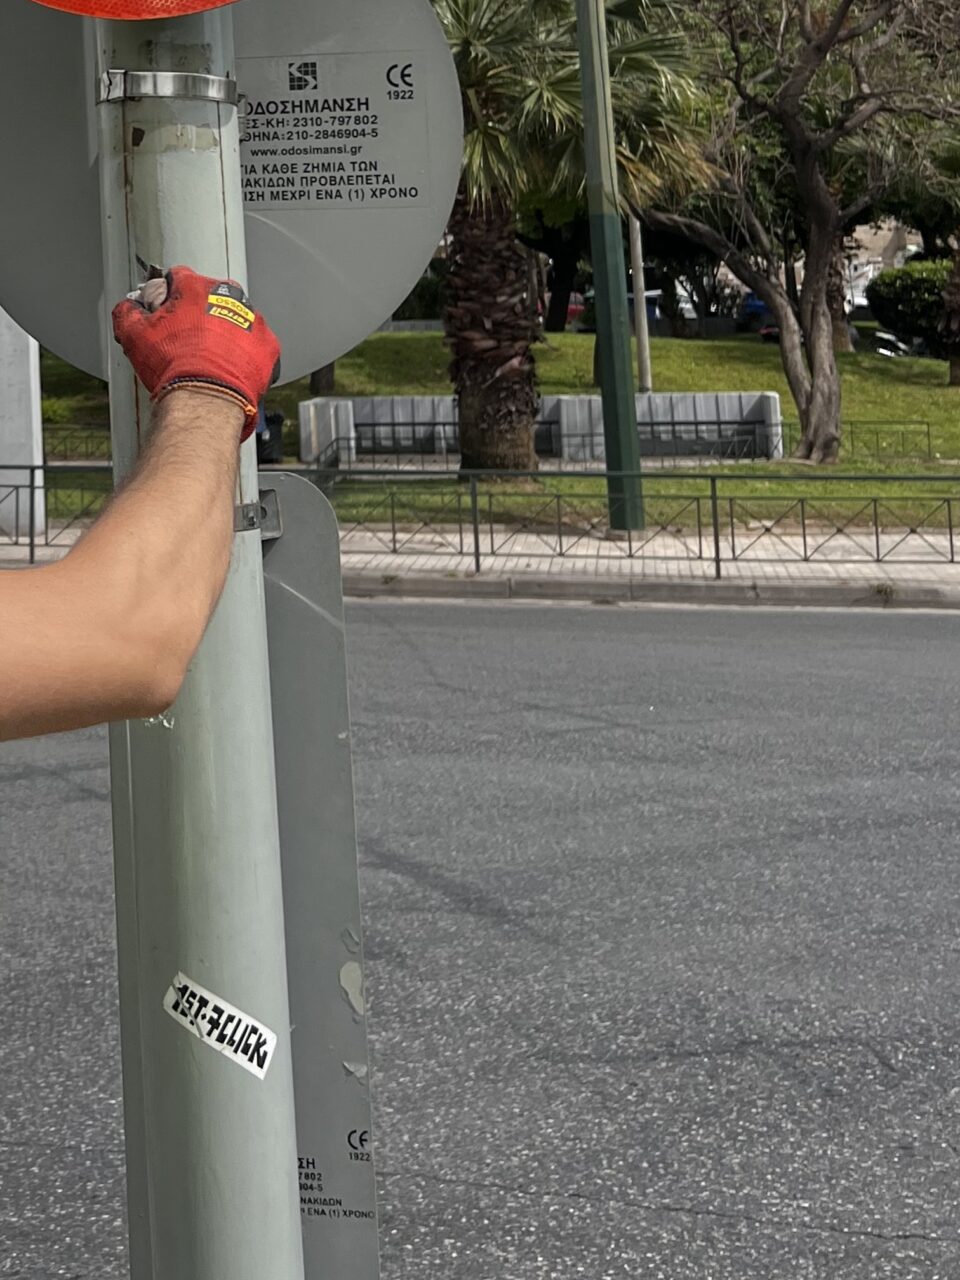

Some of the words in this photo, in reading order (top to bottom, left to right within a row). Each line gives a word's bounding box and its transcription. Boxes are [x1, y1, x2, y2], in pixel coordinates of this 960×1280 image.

[386, 90, 414, 100] 1922
[250, 144, 362, 157] www.odosimansi.gr
[240, 163, 257, 175] ΙΑ
[262, 162, 298, 174] ΚΑΘΕ
[302, 161, 346, 173] ΖΗΜΙΑ
[349, 160, 378, 172] ΤΩΝ
[241, 176, 295, 188] ΑΚΙΔΩΝ
[300, 173, 395, 187] ΠΡΟΒΛΕΠΕΤΑΙ
[270, 189, 310, 201] ΜΕΧΡΙ
[316, 189, 343, 200] ΕΝΑ
[348, 188, 365, 202] (1)
[370, 186, 418, 199] ΧΡΟΝΟ
[298, 1157, 315, 1169] ΣΗ
[349, 1152, 370, 1162] 1922
[300, 1197, 342, 1207] ΝΑΚΙΔΩΝ
